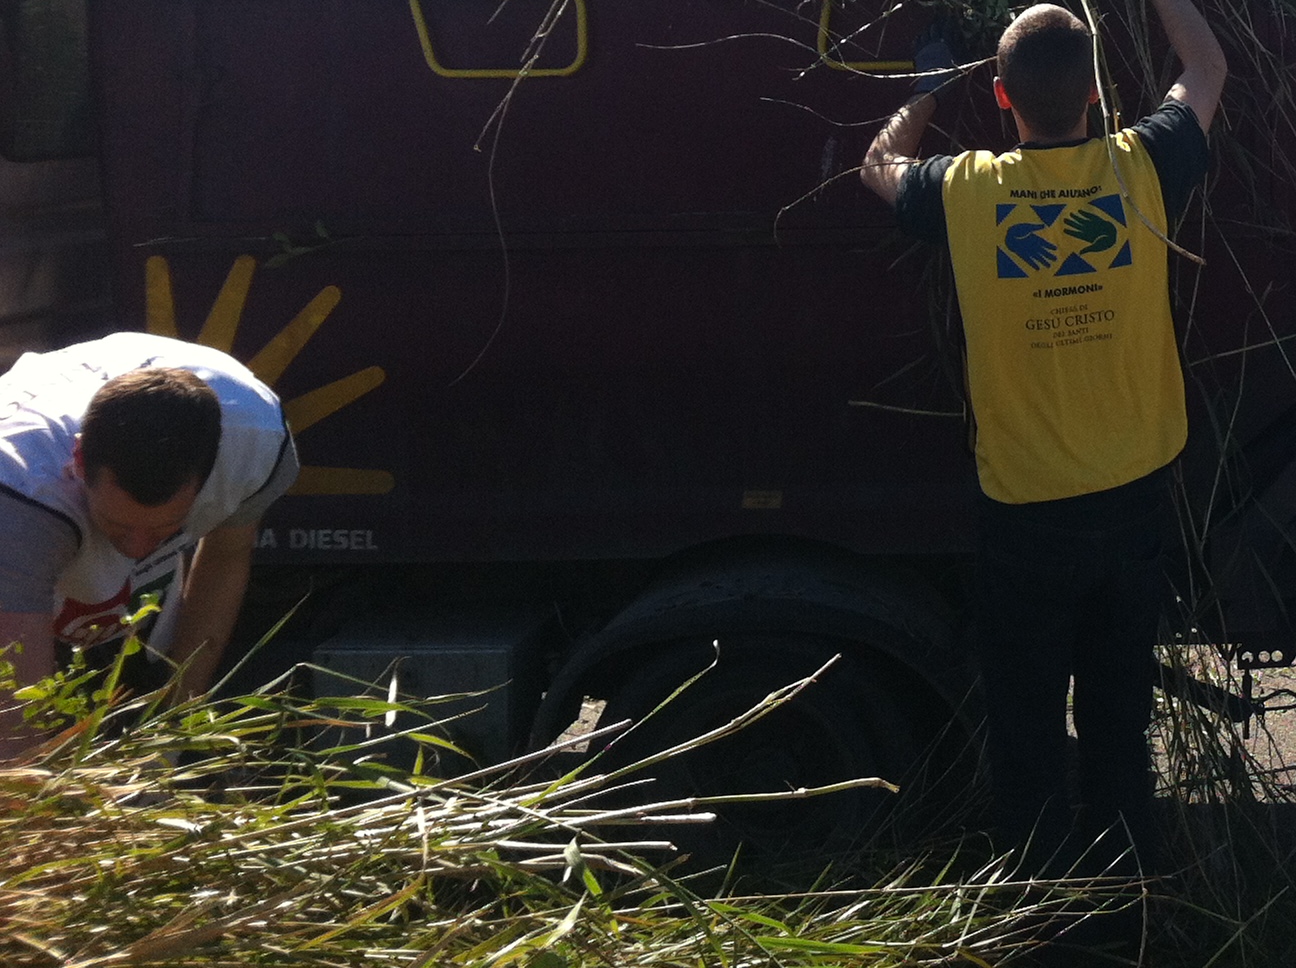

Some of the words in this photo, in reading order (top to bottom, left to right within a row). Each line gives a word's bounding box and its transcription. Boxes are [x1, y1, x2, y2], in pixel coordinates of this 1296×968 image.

[1009, 189, 1037, 200] MANI
[1039, 189, 1056, 199] CHE
[1064, 309, 1115, 328] CRISTO
[289, 528, 379, 550] DIESEL
